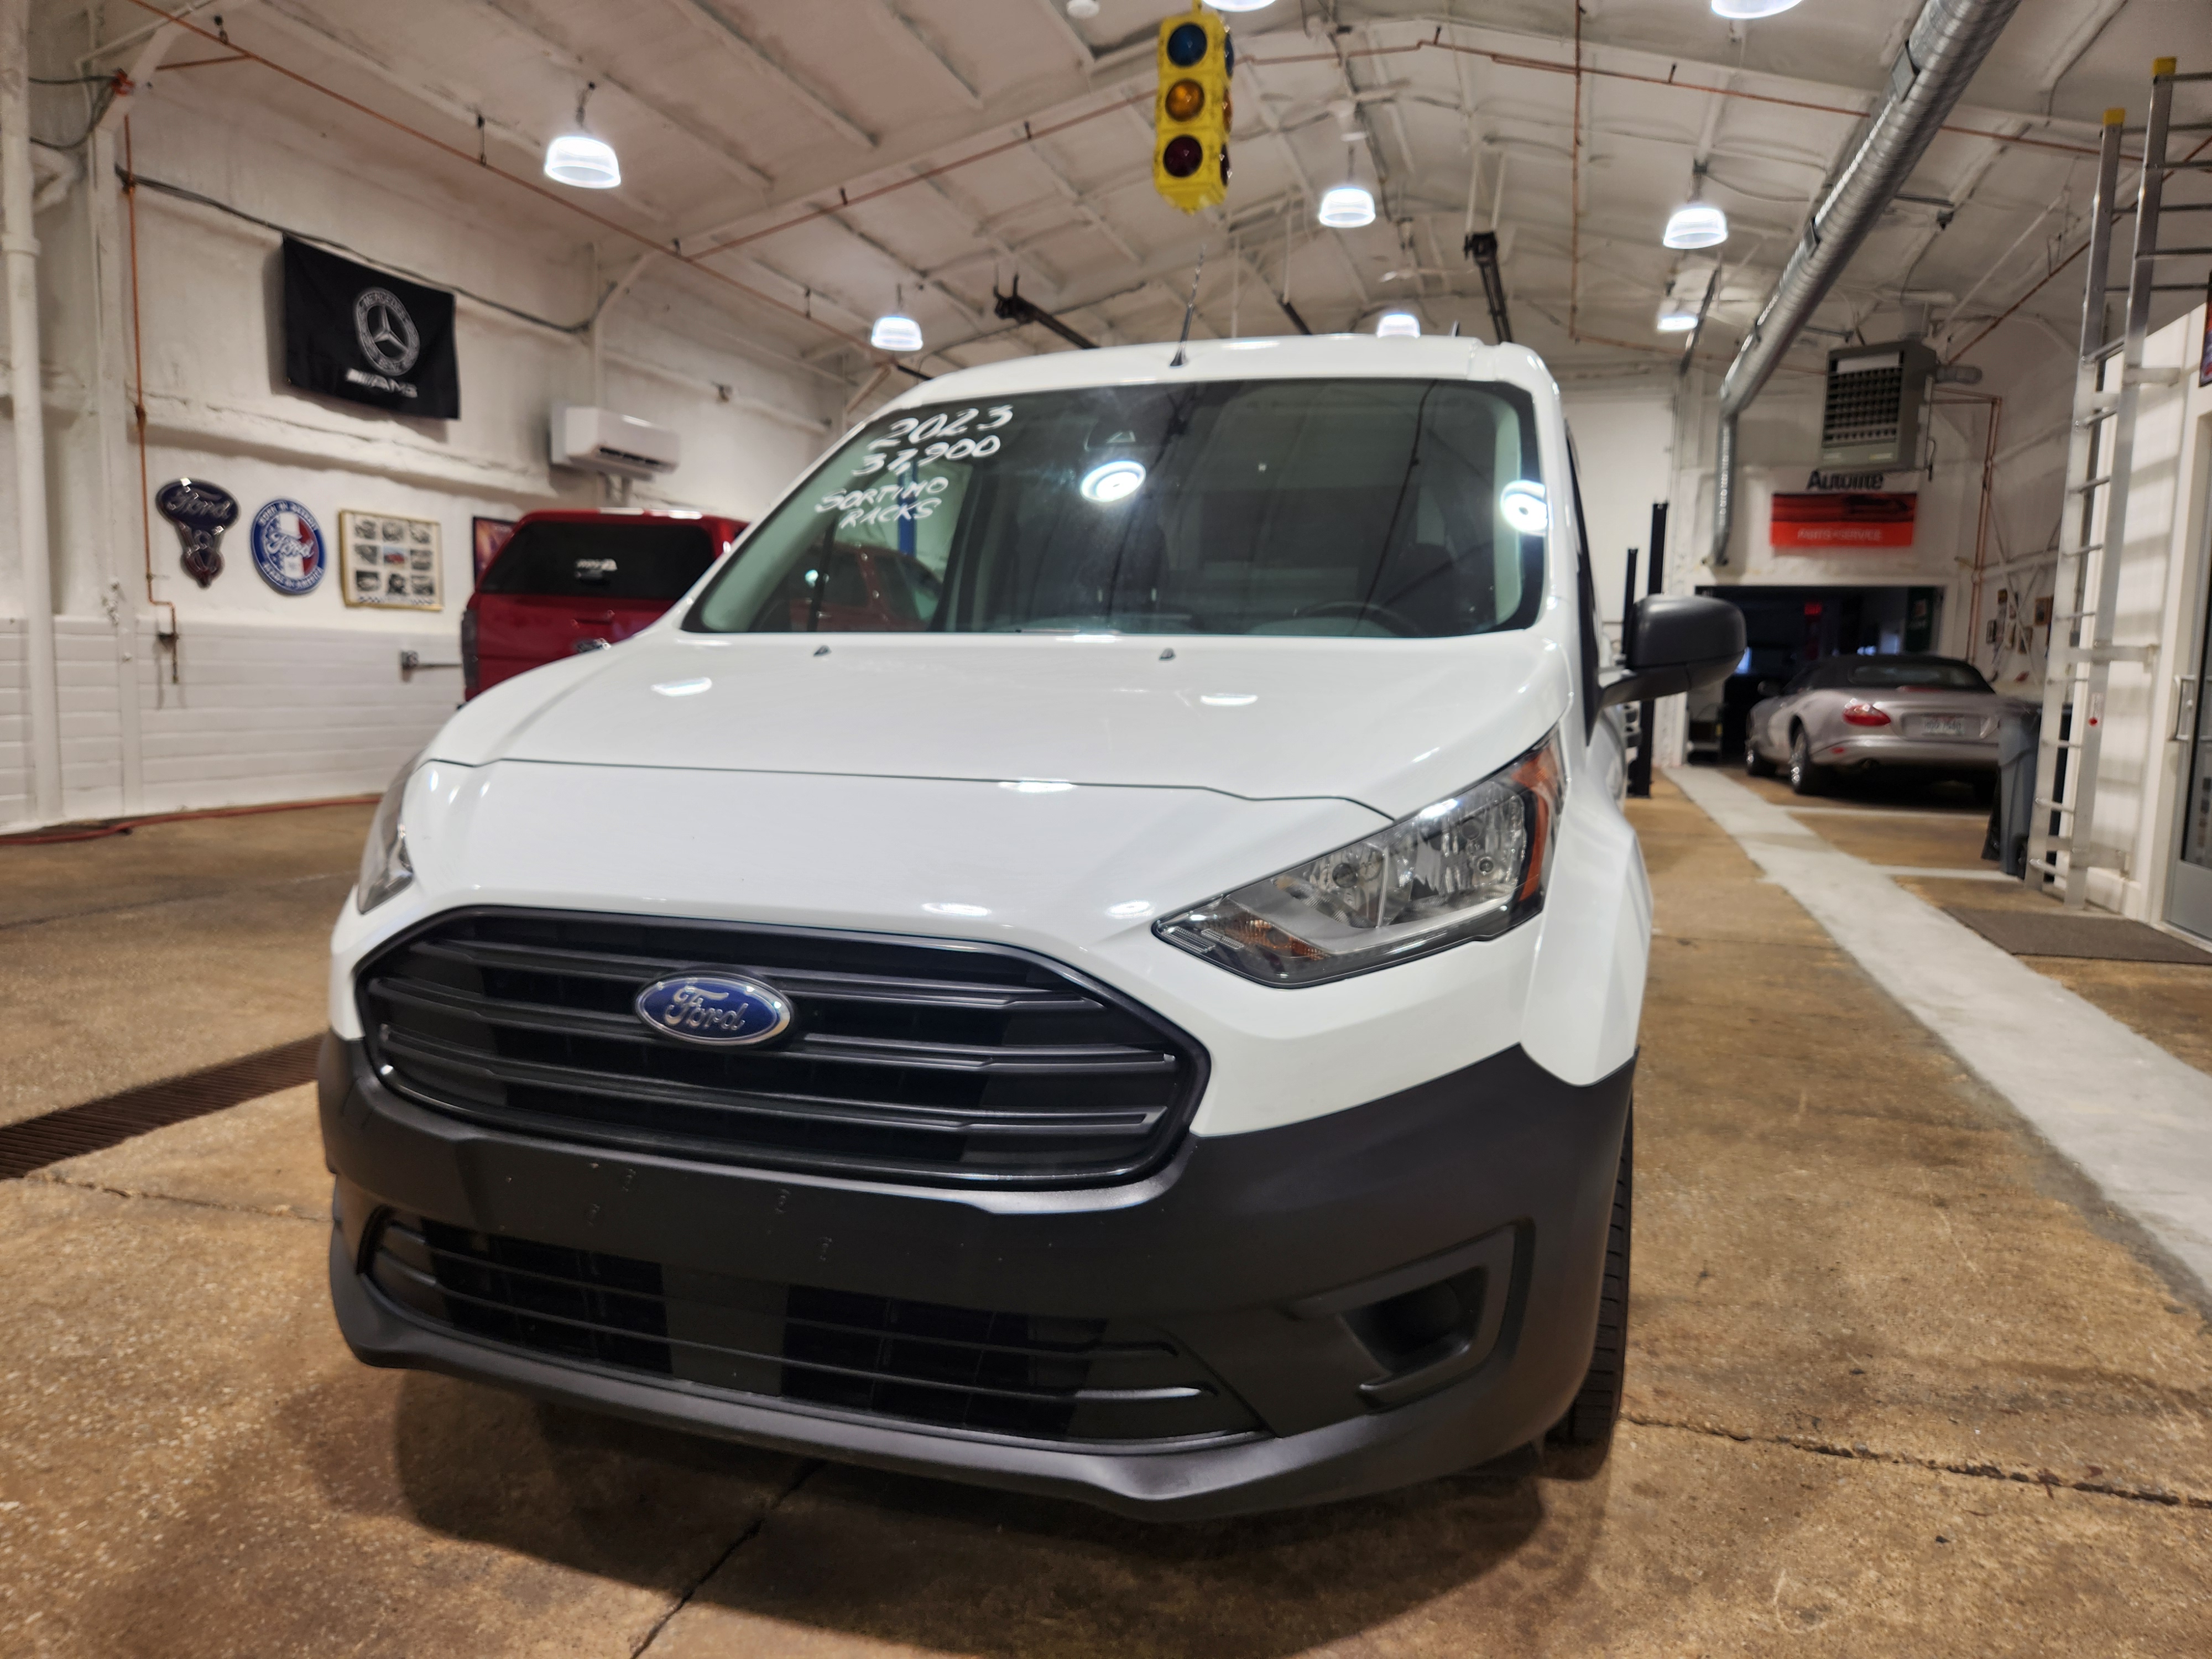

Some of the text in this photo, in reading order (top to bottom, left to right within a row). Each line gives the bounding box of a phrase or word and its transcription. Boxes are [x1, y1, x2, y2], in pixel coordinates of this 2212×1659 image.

[867, 404, 1014, 451] 2023
[166, 488, 231, 519] Ford
[814, 476, 949, 513] SORTIMO
[838, 497, 942, 529] RACKS
[267, 532, 315, 559] Ford
[665, 986, 749, 1031] Ford
